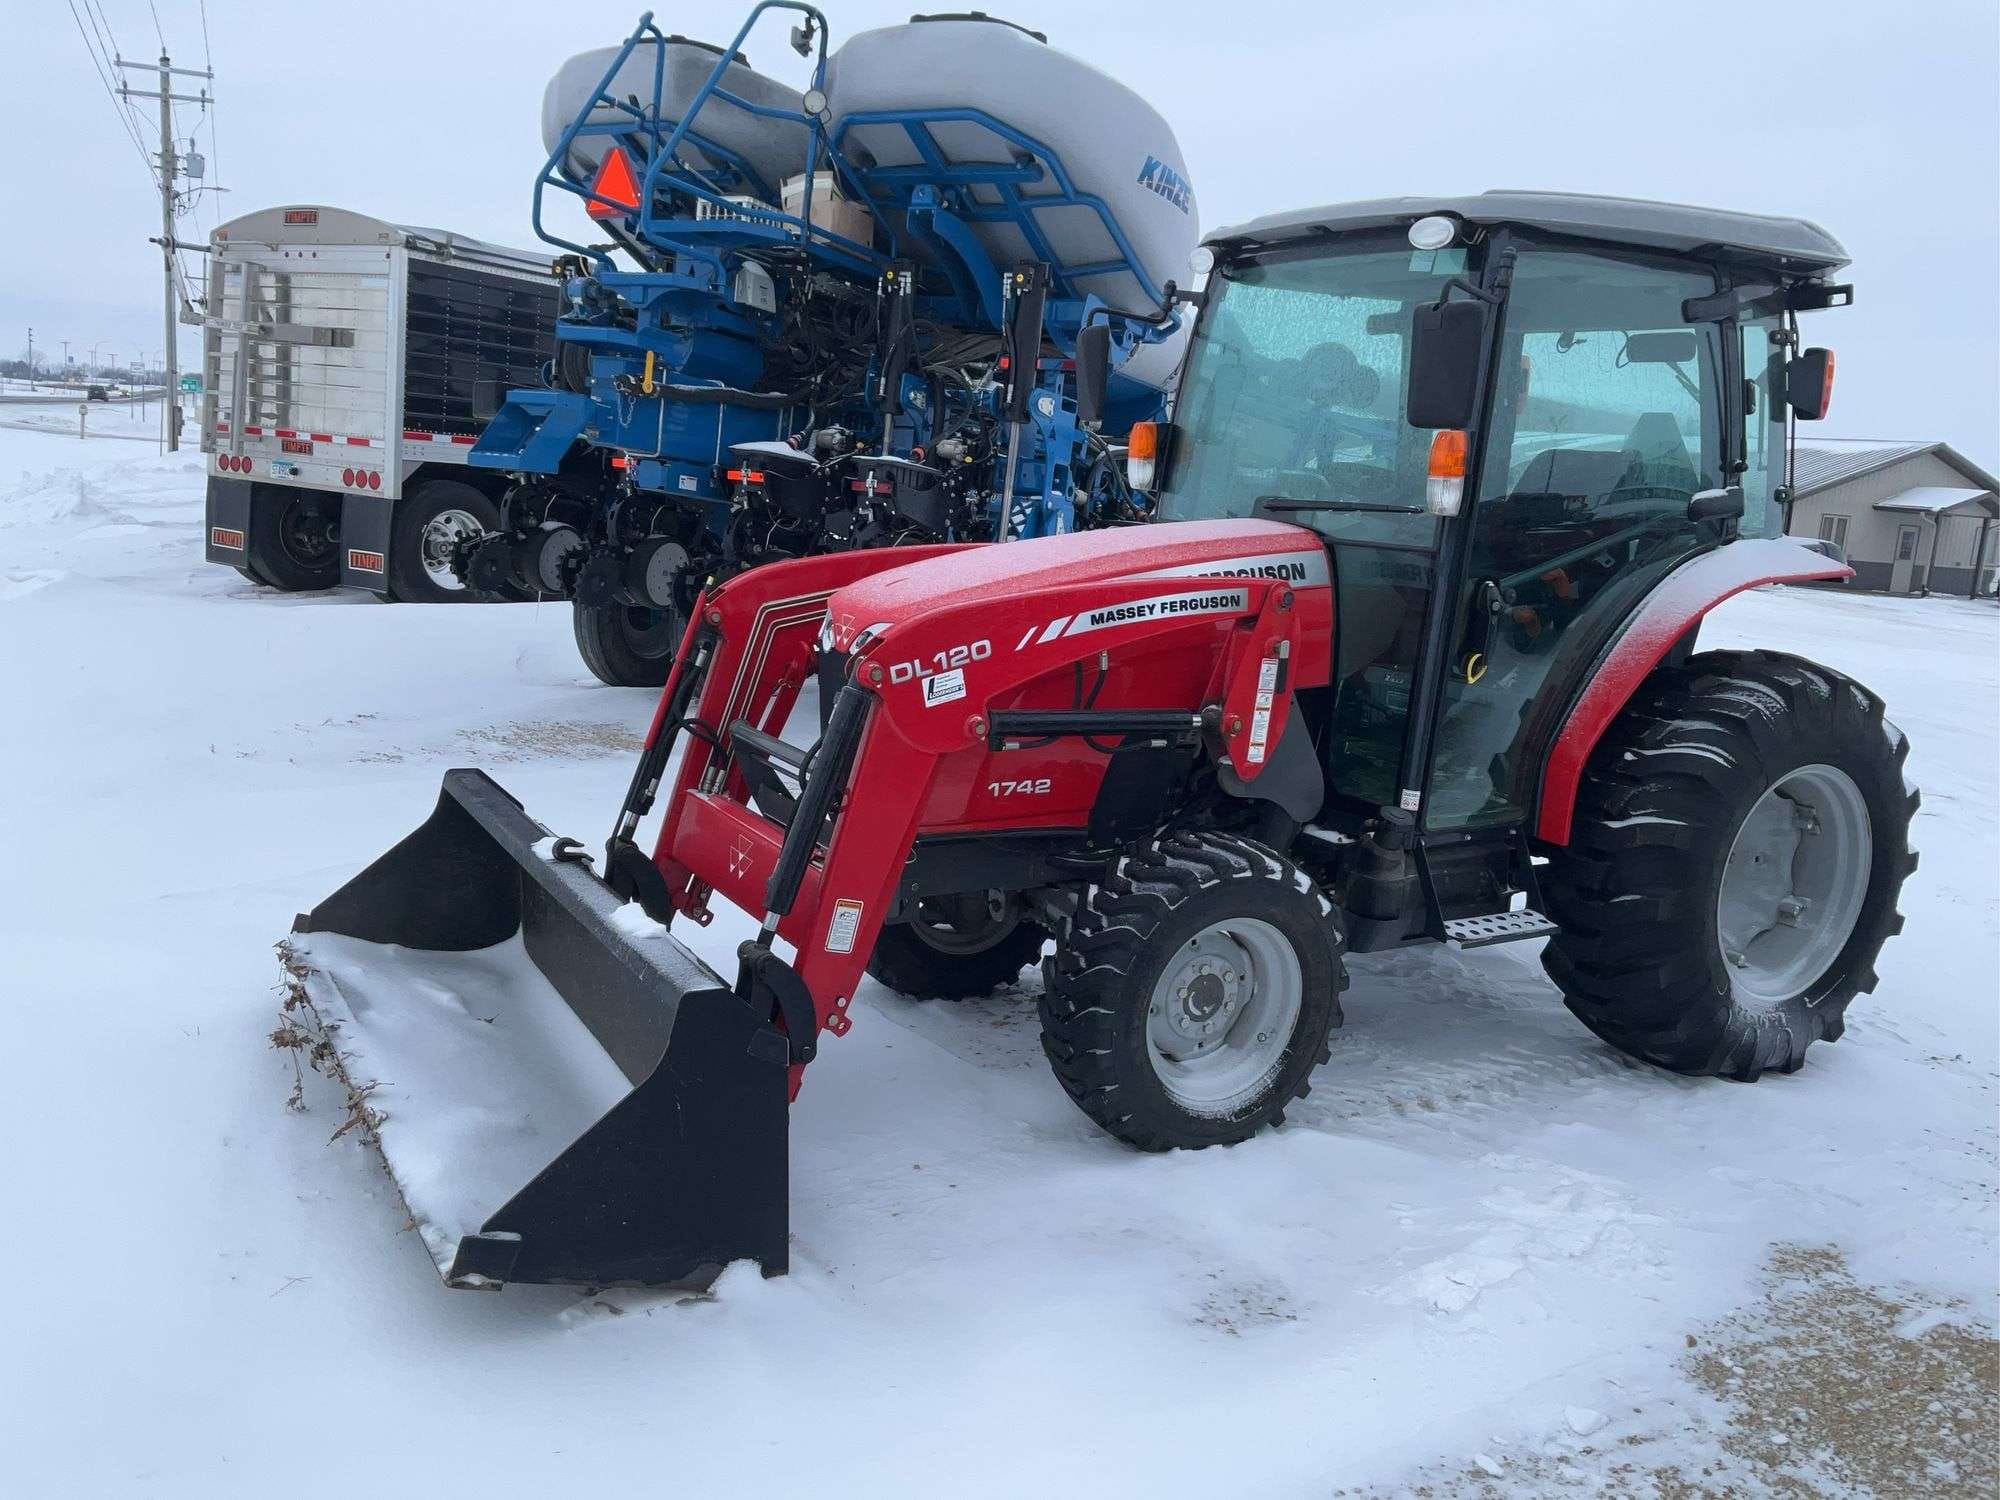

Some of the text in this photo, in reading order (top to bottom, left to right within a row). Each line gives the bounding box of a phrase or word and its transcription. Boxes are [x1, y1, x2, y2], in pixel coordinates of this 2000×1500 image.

[1137, 155, 1190, 215] KINZE
[282, 441, 312, 454] TIMPTE
[1194, 562, 1306, 581] GUSON
[1090, 594, 1241, 626] MASSEY FERGUSON
[890, 639, 992, 685] DL120
[988, 779, 1051, 797] 1742
